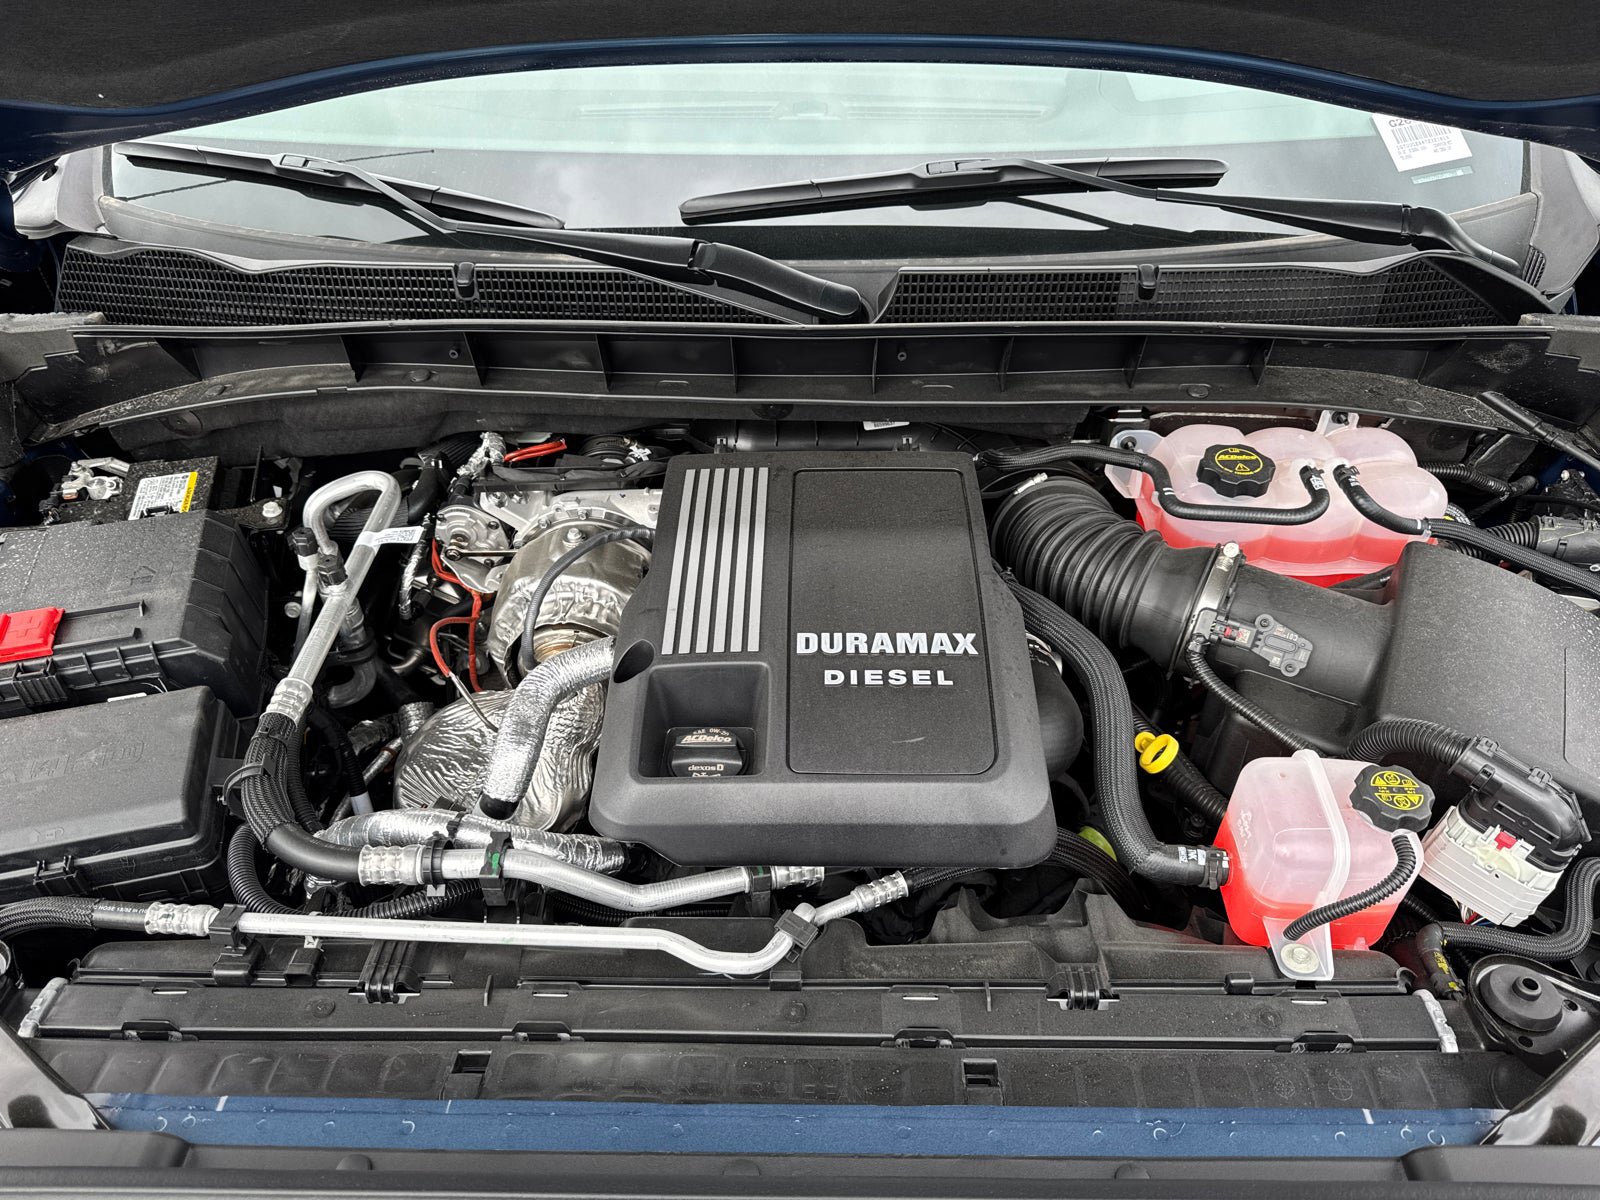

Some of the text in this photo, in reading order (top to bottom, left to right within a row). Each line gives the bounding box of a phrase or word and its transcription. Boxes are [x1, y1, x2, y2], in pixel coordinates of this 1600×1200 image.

[796, 632, 979, 655] DURAMAX
[824, 669, 954, 686] DIESEL
[681, 735, 732, 743] ACDelco
